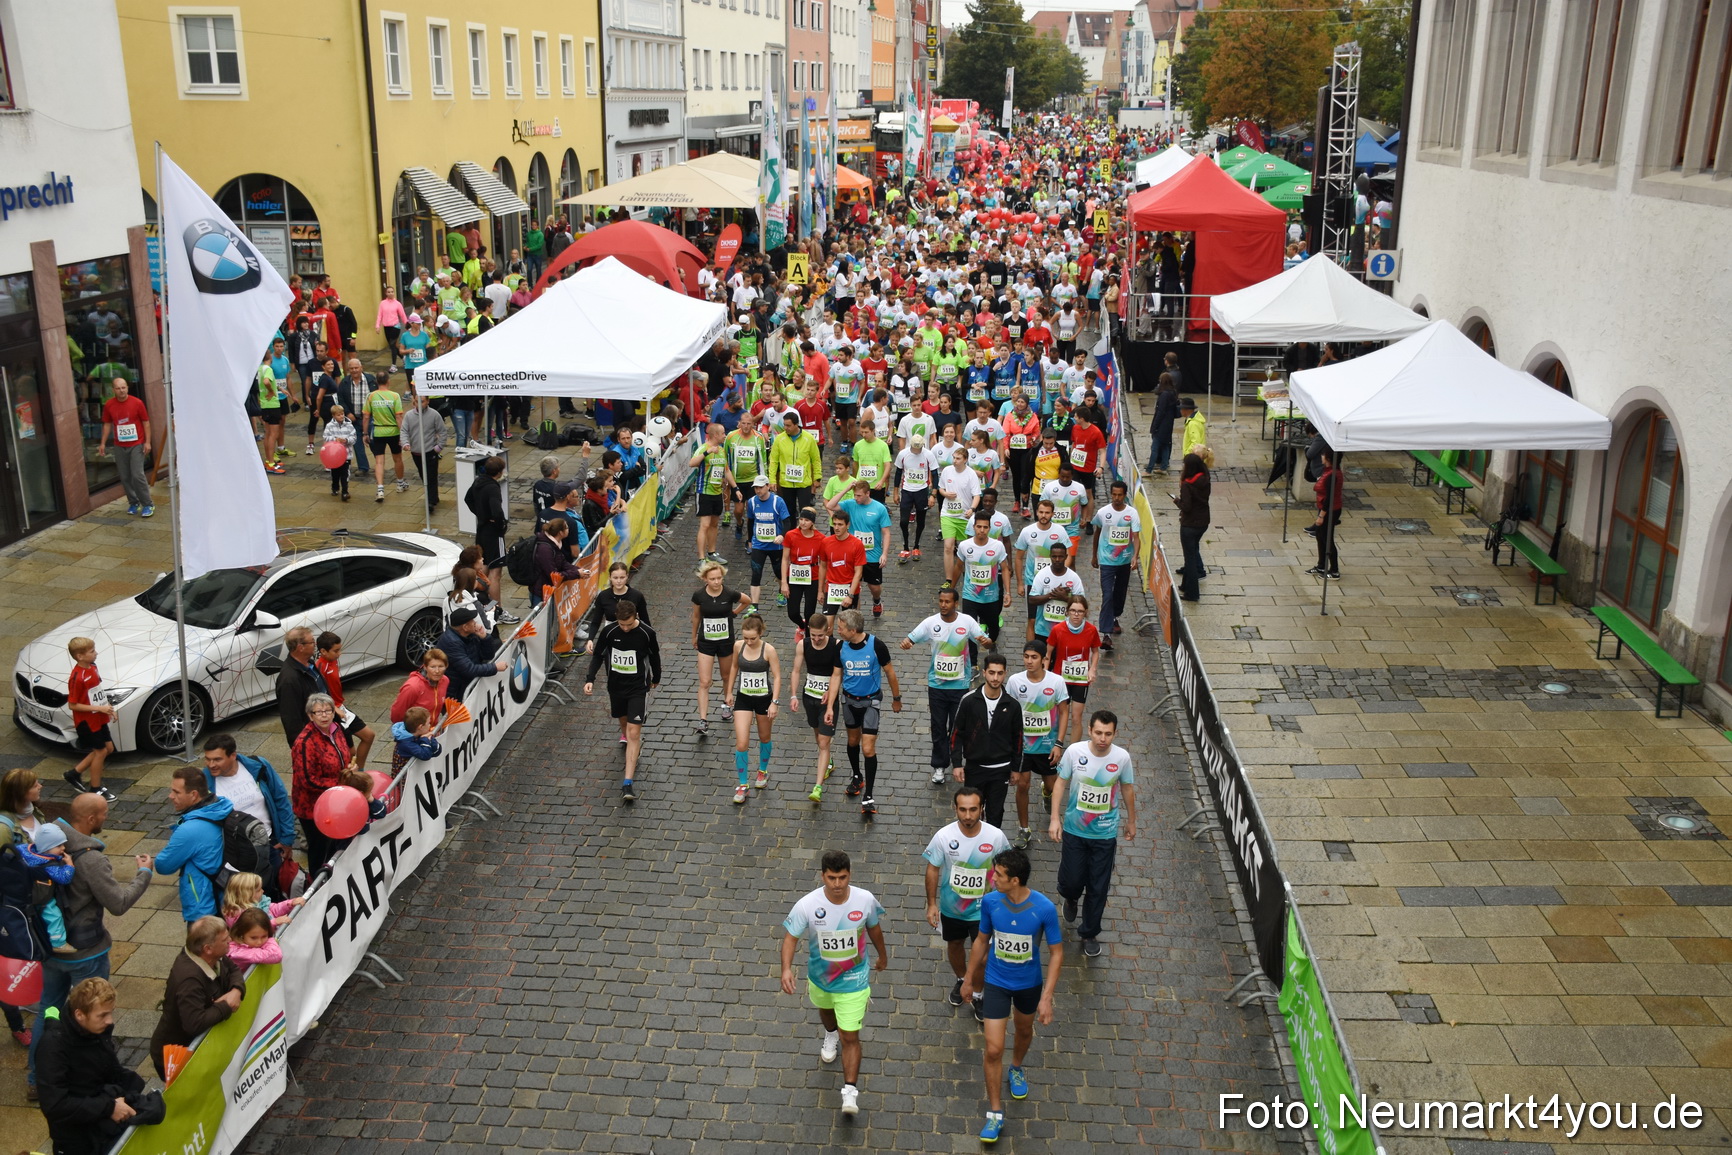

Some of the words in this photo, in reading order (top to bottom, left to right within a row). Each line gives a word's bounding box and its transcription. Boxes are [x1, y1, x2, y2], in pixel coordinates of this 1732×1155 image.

[928, 26, 937, 80] HOTEL
[1102, 164, 1109, 173] B
[247, 200, 283, 210] hailer
[1097, 217, 1106, 228] A
[792, 262, 804, 278] A
[426, 372, 456, 381] BMW
[458, 371, 547, 381] ConnectedDrive
[786, 468, 802, 477] 5196
[860, 469, 876, 477] 5325
[908, 472, 924, 480] 5243
[757, 528, 775, 536] 5188
[1111, 531, 1129, 539] 5250
[791, 570, 810, 578] 5088
[971, 569, 990, 579] 5237
[830, 588, 849, 597] 5089
[706, 623, 727, 633] 5400
[613, 654, 634, 666] 5170
[936, 661, 958, 672] 5207
[1064, 665, 1086, 676] 5197
[743, 678, 764, 688] 5181
[1024, 716, 1048, 727] 5201
[1081, 790, 1109, 804] 5210
[953, 873, 983, 888] 5203
[822, 936, 855, 950] 5314
[998, 938, 1029, 953] 5249
[240, 1084, 263, 1111] einkaufen
[264, 1071, 277, 1087] leben
